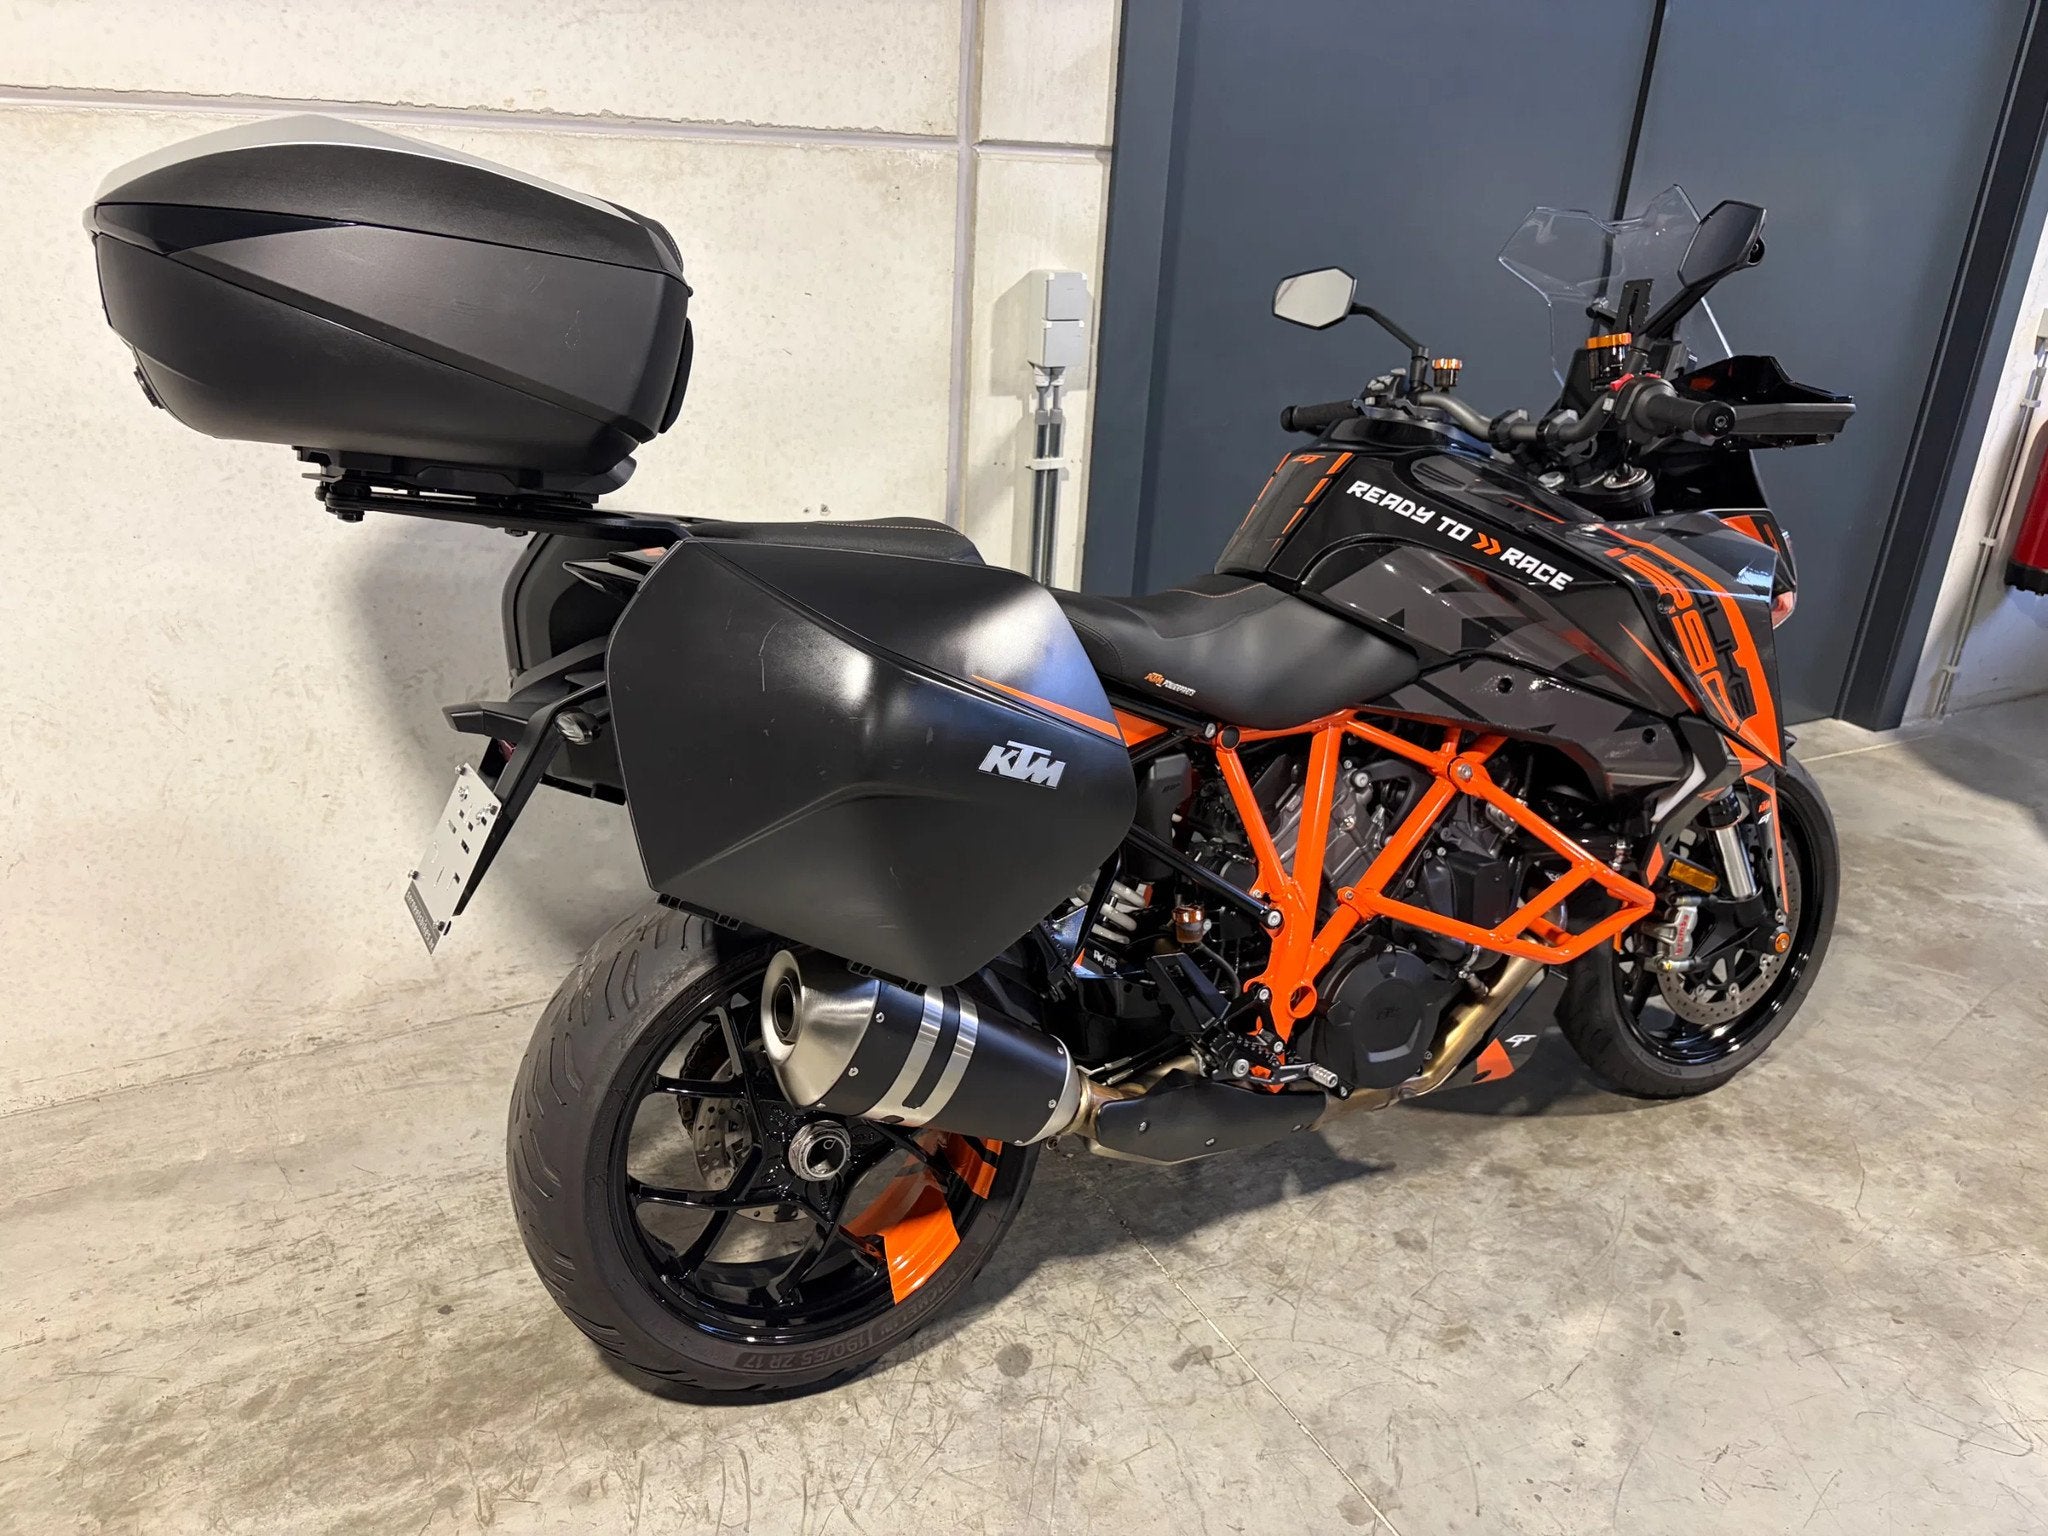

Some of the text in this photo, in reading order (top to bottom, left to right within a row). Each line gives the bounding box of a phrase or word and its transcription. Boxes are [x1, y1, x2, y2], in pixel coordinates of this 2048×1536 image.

[1346, 480, 1436, 524] READY
[1436, 515, 1473, 542] TO
[1500, 547, 1574, 591] RACE
[978, 740, 1066, 788] KTM
